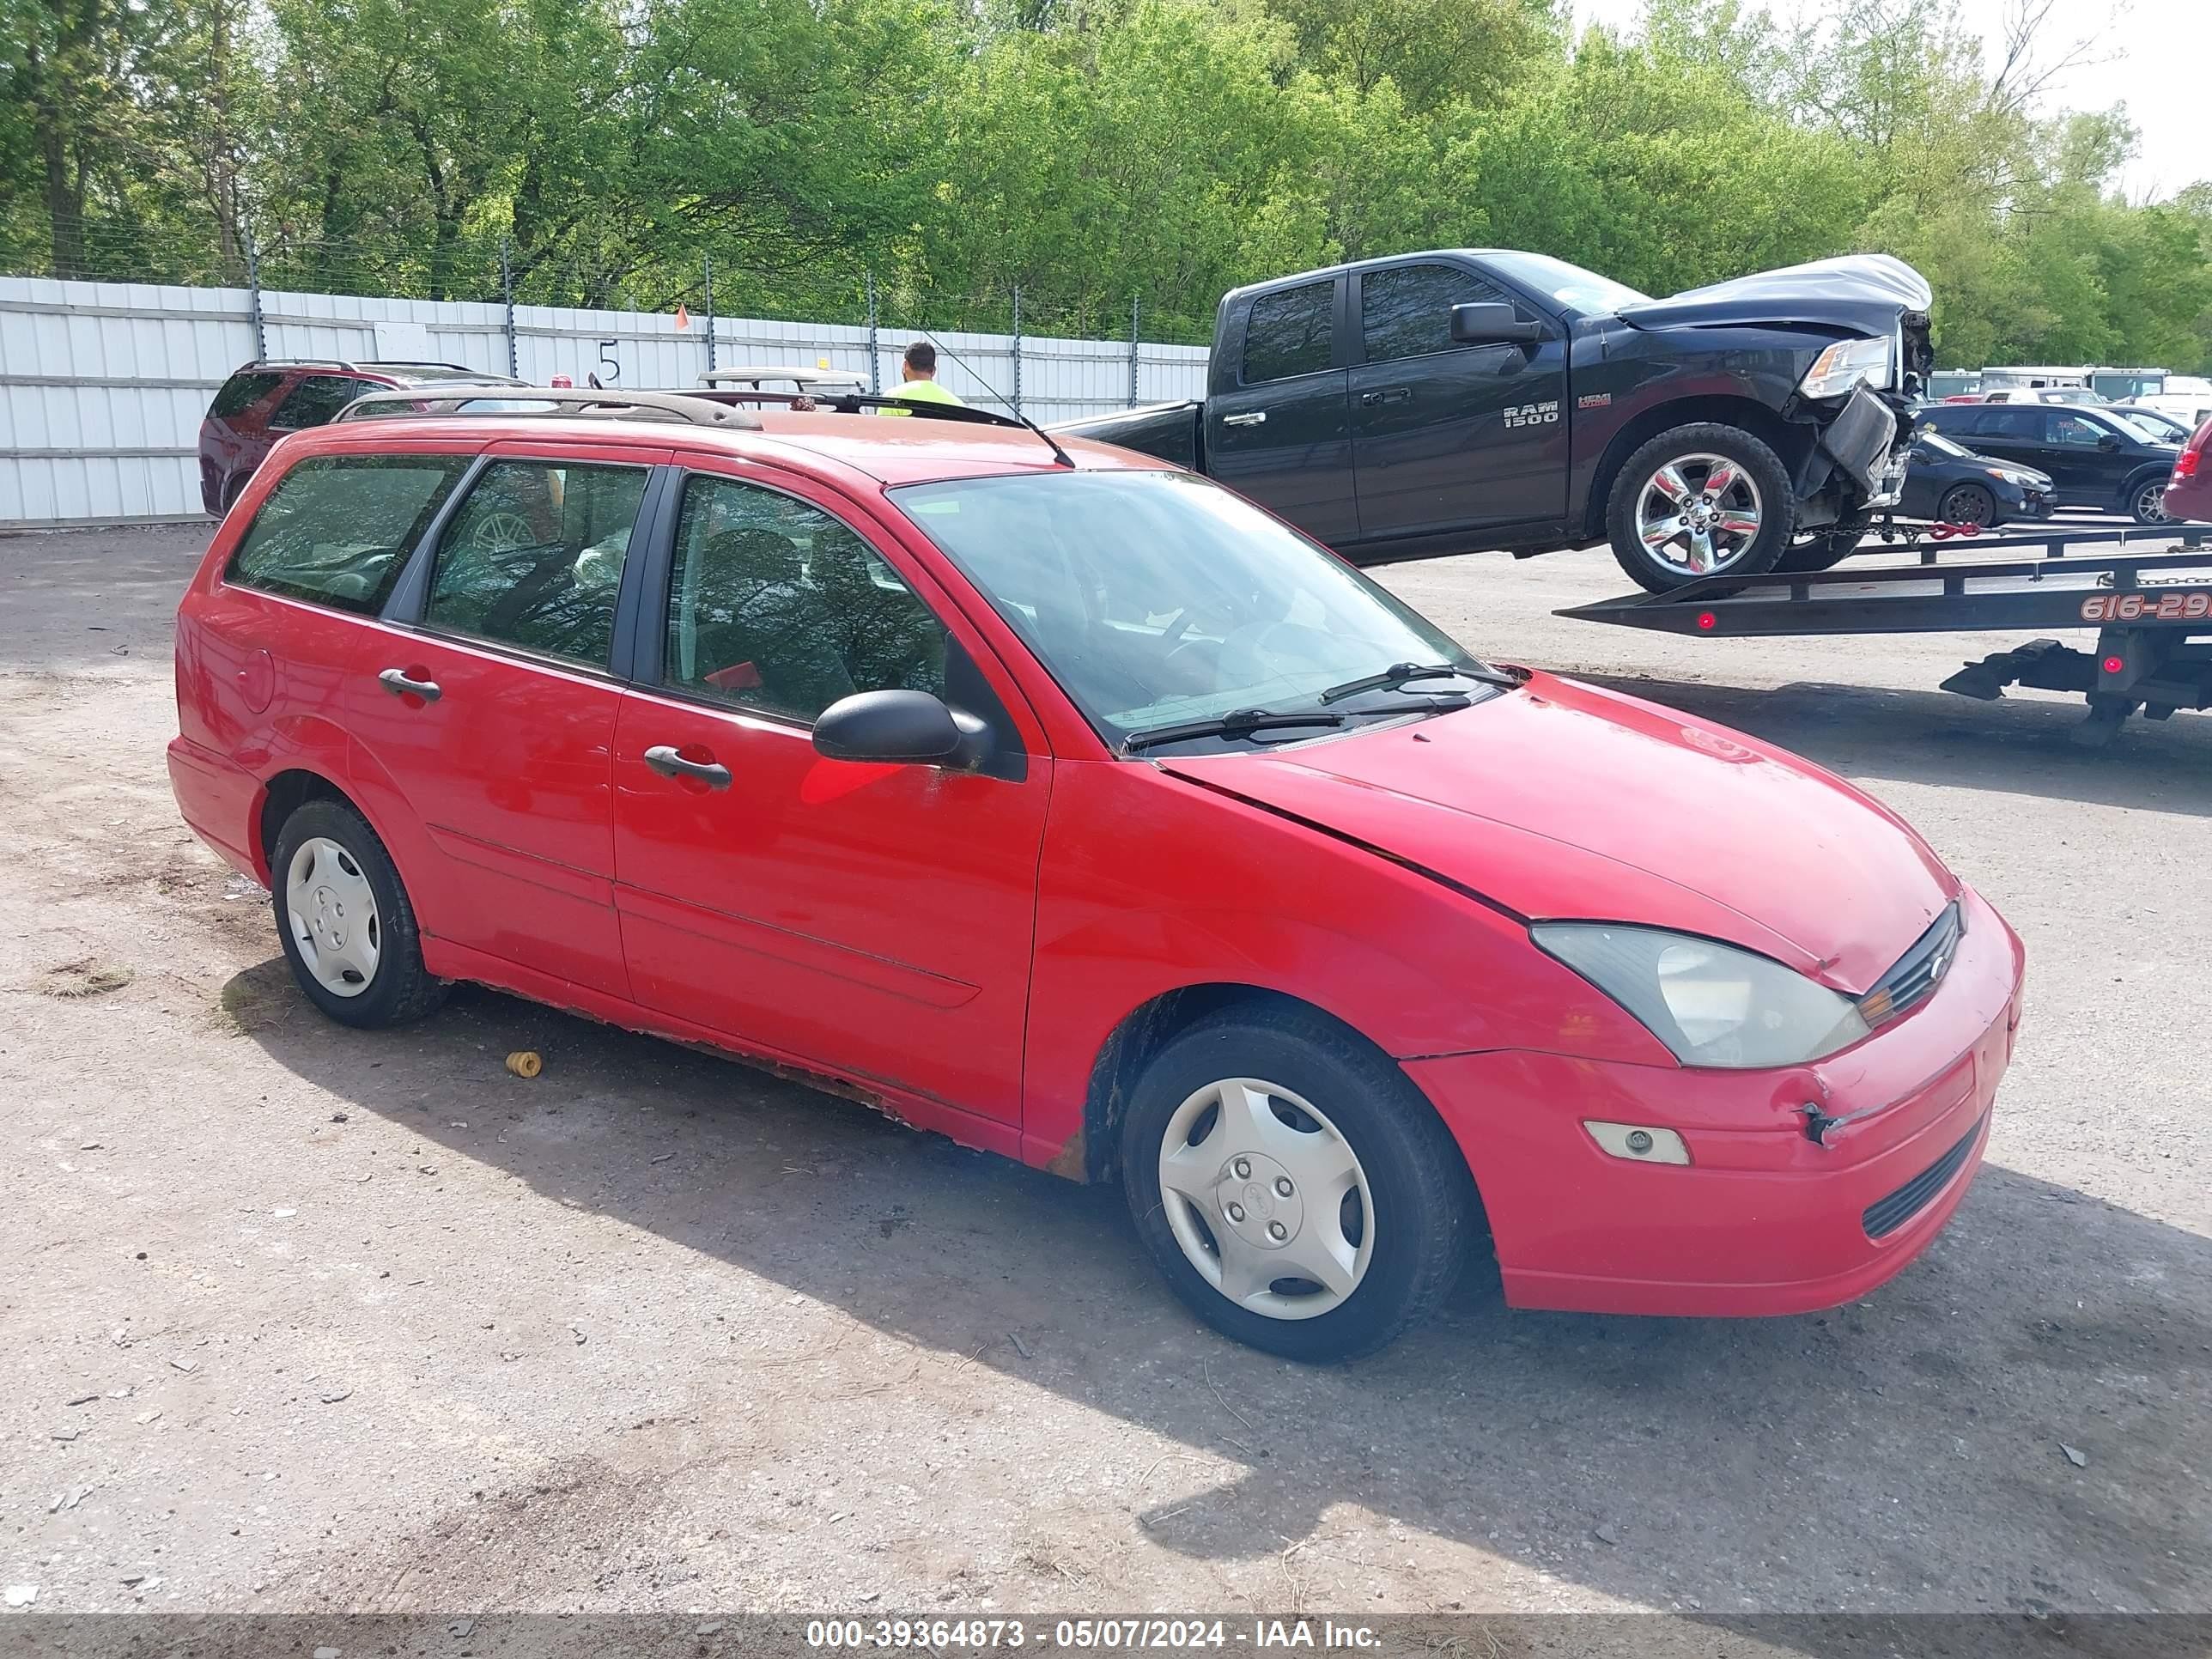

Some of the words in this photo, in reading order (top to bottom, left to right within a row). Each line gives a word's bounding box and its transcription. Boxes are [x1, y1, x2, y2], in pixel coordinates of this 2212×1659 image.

[600, 339, 620, 381] 5
[1577, 392, 1612, 404] HEMI
[1503, 400, 1559, 418] RAM
[1504, 411, 1559, 428] 1500
[2081, 592, 2212, 622] 616-29
